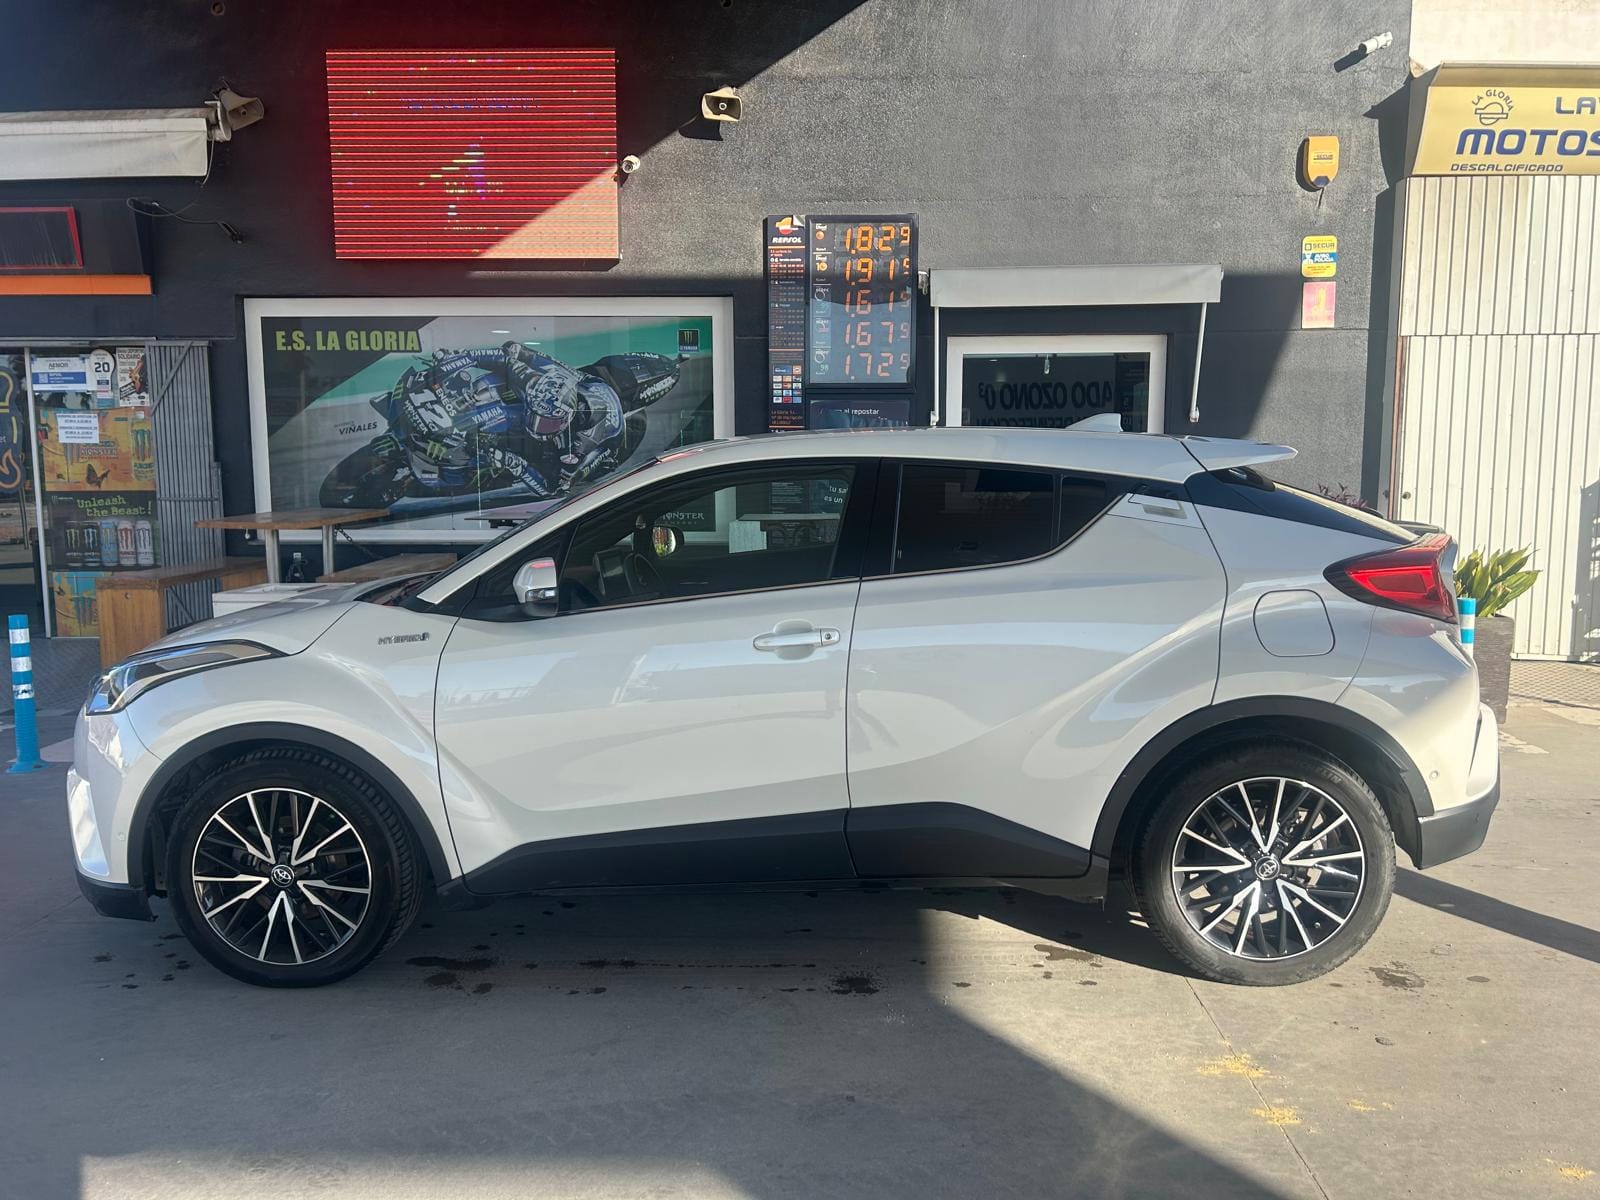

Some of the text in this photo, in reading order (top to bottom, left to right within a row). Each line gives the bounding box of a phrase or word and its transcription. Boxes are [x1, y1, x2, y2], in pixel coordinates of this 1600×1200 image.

[1472, 89, 1514, 112] LA GLORIA
[1556, 96, 1600, 115] LA
[1450, 163, 1564, 172] DESCALCIFICADO
[772, 236, 803, 244] REPSOL
[275, 330, 421, 351] E.S. LA GLORIA
[94, 362, 110, 373] 20
[435, 388, 457, 417] ENEOS
[471, 405, 503, 424] YAMAHA
[851, 407, 880, 416] repostar
[838, 486, 849, 494] sa
[76, 494, 127, 509] Unleash
[833, 496, 843, 504] un
[86, 507, 108, 517] the
